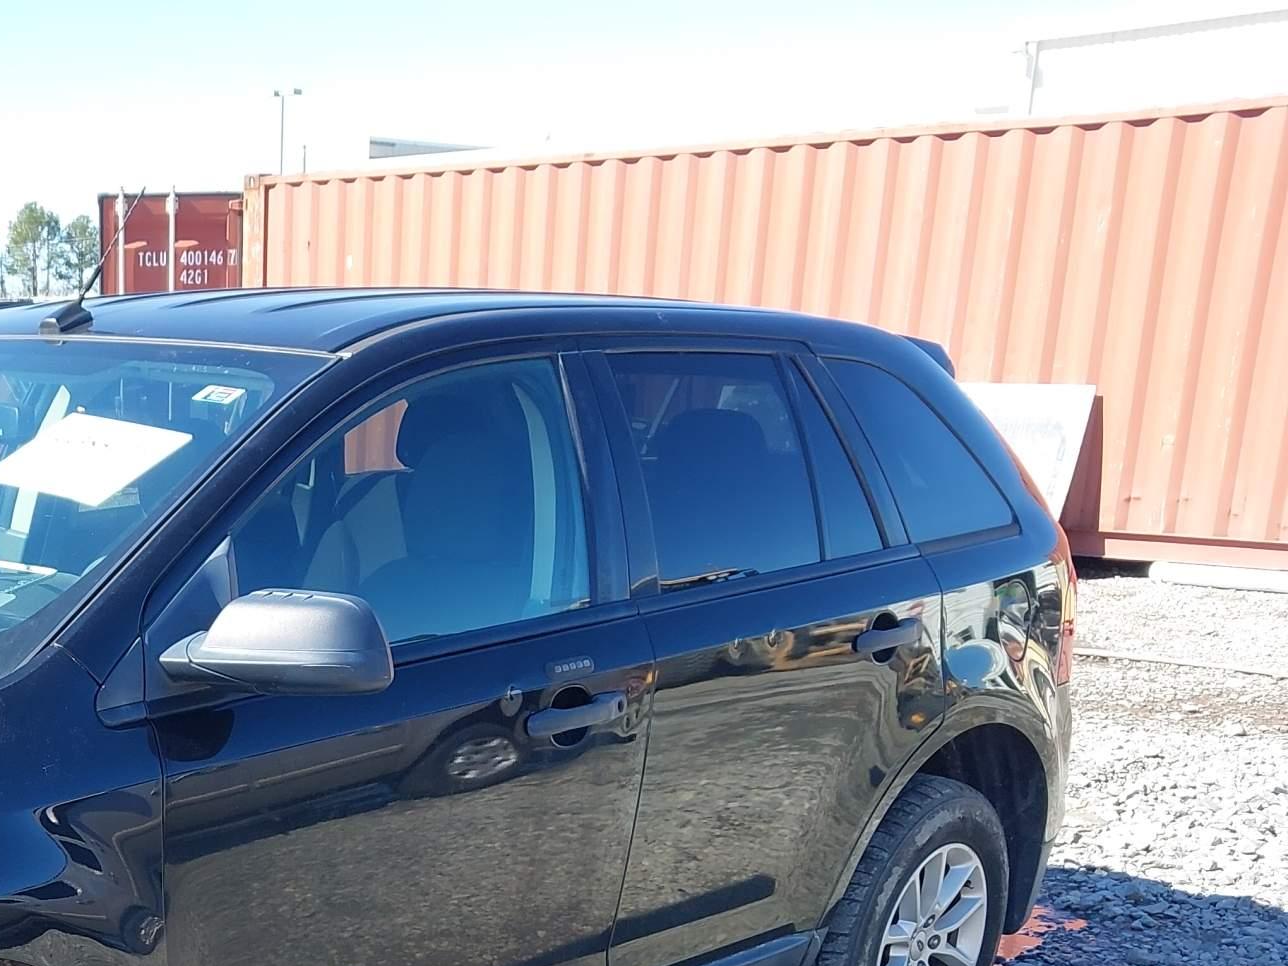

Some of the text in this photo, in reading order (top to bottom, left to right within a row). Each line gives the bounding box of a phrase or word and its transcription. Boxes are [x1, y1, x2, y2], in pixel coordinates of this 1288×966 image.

[138, 250, 167, 267] TCLU
[180, 250, 224, 266] 400146
[180, 269, 208, 285] 42G1
